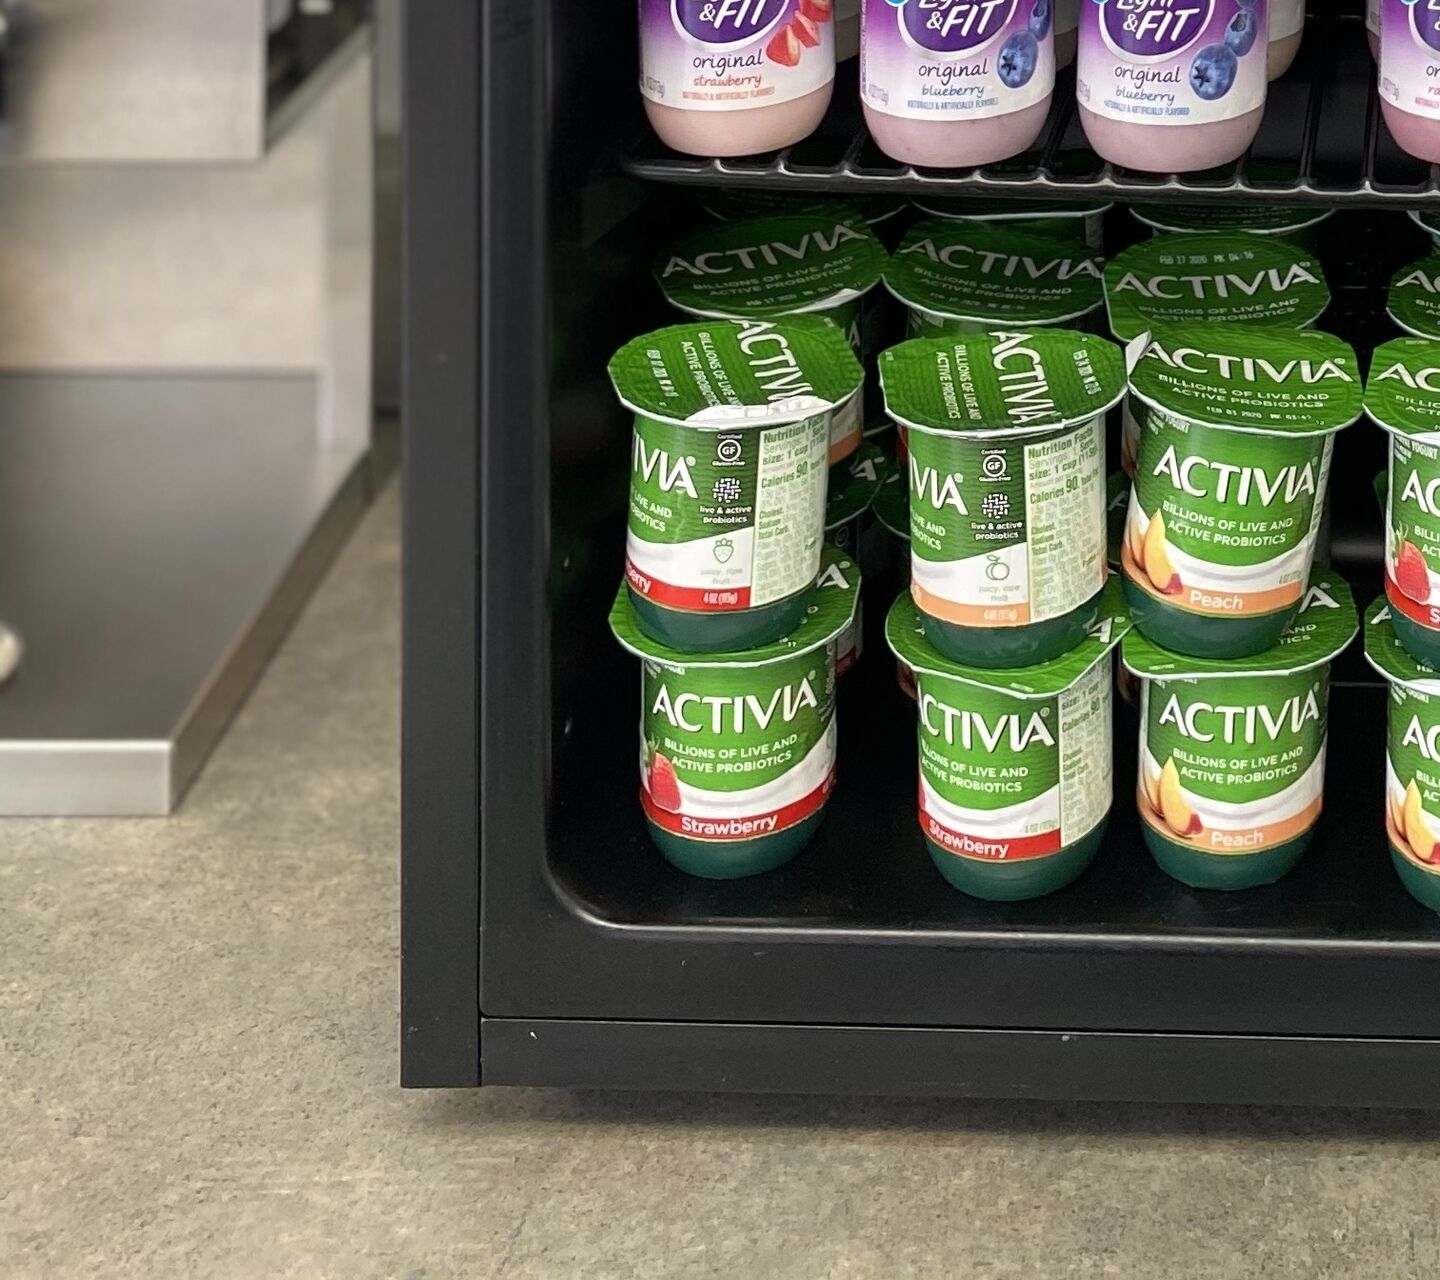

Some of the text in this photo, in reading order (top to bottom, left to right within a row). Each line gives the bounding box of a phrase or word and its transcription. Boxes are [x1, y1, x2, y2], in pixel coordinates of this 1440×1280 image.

[692, 49, 764, 76] original
[918, 58, 988, 86] original
[1114, 65, 1181, 86] original
[693, 73, 762, 88] strawberry
[921, 84, 985, 97] blueberry
[1115, 86, 1176, 103] blueberry
[662, 223, 868, 278] ACTIVIA
[901, 239, 1103, 280] ACTIVIA
[1115, 263, 1320, 298] ACTIVIA
[1138, 343, 1353, 383] ACTIVIA
[1152, 444, 1317, 507] ACTIVIA
[703, 516, 748, 524] probiotics
[1190, 589, 1243, 611] Peach
[652, 676, 817, 735] ACTIVIA
[1159, 688, 1319, 744] ACTIVIA
[664, 734, 797, 759] BILLIONS OF LIVE AND
[671, 750, 793, 774] ACTIVE PROBIOTICS
[681, 813, 779, 837] Strawberry
[1210, 829, 1264, 847] Peach
[928, 820, 1010, 858] Strawberry
